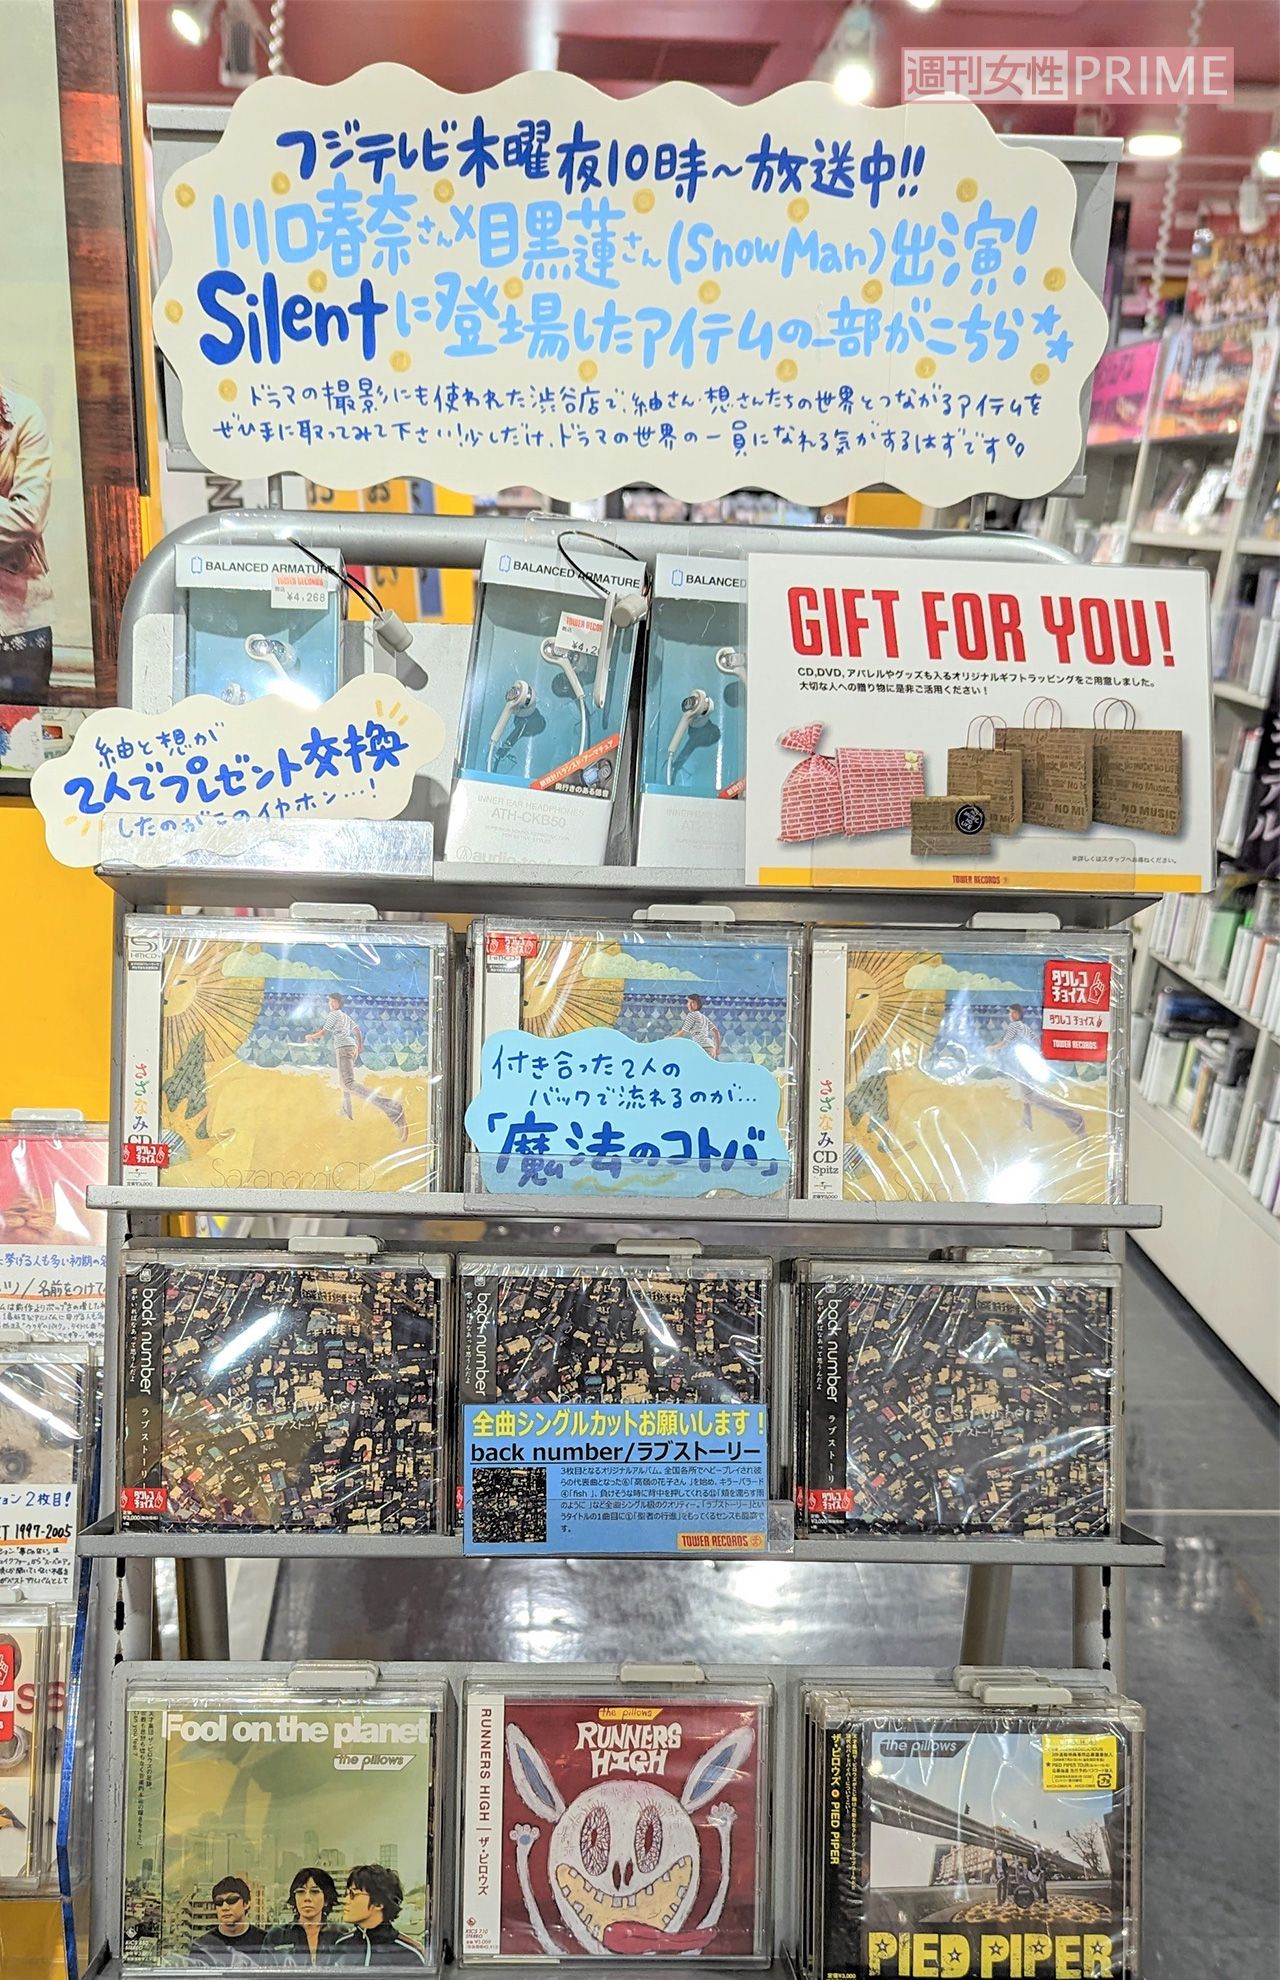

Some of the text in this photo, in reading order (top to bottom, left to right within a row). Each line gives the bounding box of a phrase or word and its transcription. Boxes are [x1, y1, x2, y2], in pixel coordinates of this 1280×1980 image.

[205, 560, 269, 574] BALANCED
[513, 561, 641, 590] BALANCED ARMATURE
[685, 574, 747, 588] BALANCED
[286, 591, 327, 602] ¥4,268
[786, 586, 1176, 668] GIFT FOR YOU!
[571, 640, 600, 656] ¥4,2
[95, 722, 226, 770] 紬と想が
[63, 719, 409, 815] 2人でプレゼント交換
[1051, 969, 1088, 988] タワレコ
[1051, 985, 1087, 1004] チョイス
[1049, 1014, 1095, 1027] タワレコ チョイス
[491, 1044, 681, 1080] 付き合った2人の
[132, 1062, 149, 1132] さざなみ
[818, 1079, 835, 1148] さざなみ
[487, 1110, 779, 1188] 「魔法のコトバ」
[812, 1150, 838, 1164] CD
[812, 1164, 840, 1177] Spitz
[139, 1287, 153, 1396] back number
[475, 1293, 490, 1397] back number
[826, 1299, 842, 1403] back number
[472, 1410, 766, 1438] 全曲シングルカットお願いします！
[471, 1440, 762, 1463] back number/ラブストーリー
[15, 1522, 74, 1541] 1997-2005
[681, 1535, 749, 1547] TOWER RECORDS
[600, 1706, 653, 1720] the pillows
[161, 1713, 227, 1743] Fool
[231, 1719, 273, 1743] on
[276, 1715, 329, 1743] the
[333, 1715, 430, 1749] planet
[575, 1721, 683, 1751] RUNNERS
[884, 1738, 958, 1755] the pillows
[337, 1753, 405, 1770] the pillows
[479, 1707, 492, 1822] RUNNERS HIGH
[591, 1748, 669, 1779] HIGH
[830, 1733, 841, 1866] ザ・ピロウズ PIED PIPER
[867, 1930, 1115, 1980] PIED PIPER
